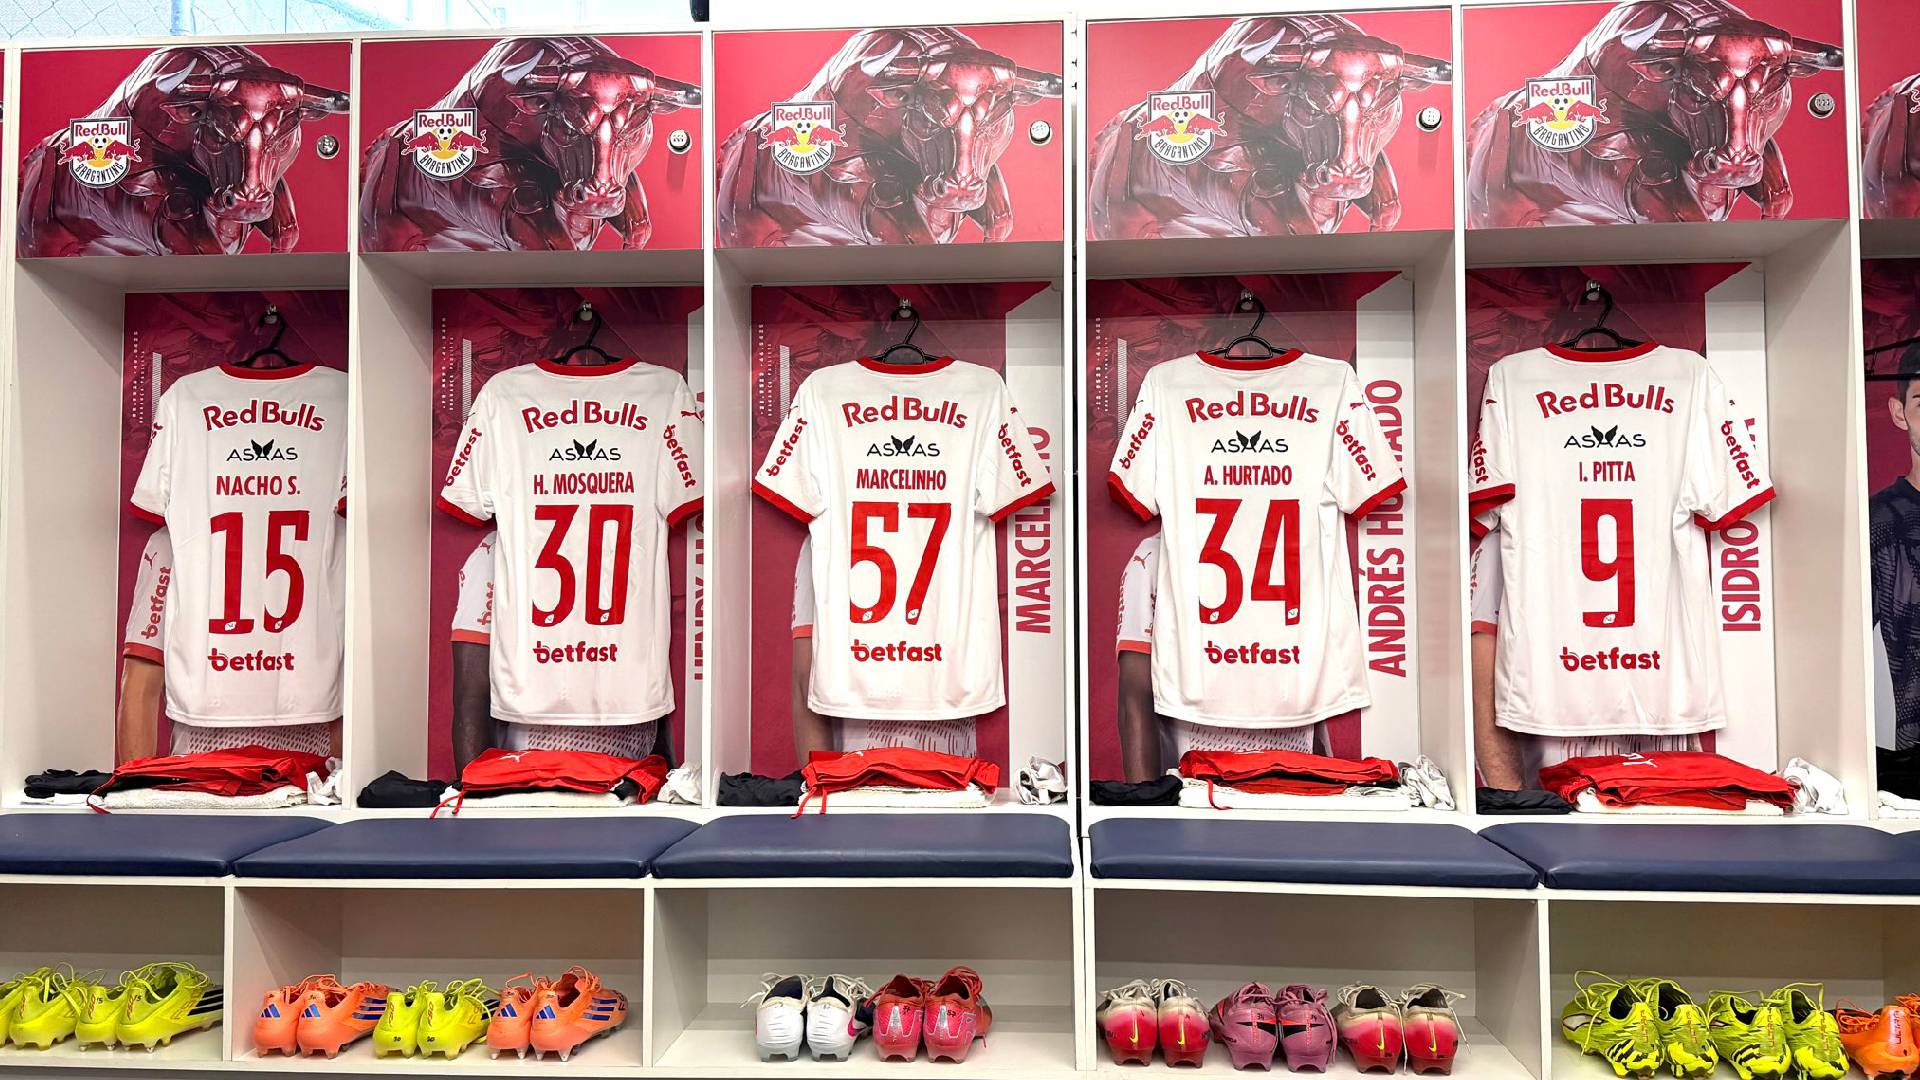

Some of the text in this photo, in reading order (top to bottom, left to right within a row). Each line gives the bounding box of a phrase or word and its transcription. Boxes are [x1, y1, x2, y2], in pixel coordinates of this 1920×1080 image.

[203, 400, 325, 433] Red Bulls
[522, 400, 649, 433] Red Bulls
[843, 395, 968, 430] Red Bulls
[1185, 391, 1319, 424] Red Bulls
[1536, 383, 1675, 418] Red Bulls
[446, 427, 482, 488] betfast
[663, 424, 696, 488] betfast
[766, 416, 808, 478] betfast
[998, 423, 1031, 487] betfast
[1119, 413, 1155, 470] betfast
[1335, 419, 1377, 482] betfast
[1720, 419, 1761, 490] betfast
[216, 475, 301, 496] NACHO S.
[533, 471, 635, 495] H. MOSQUERA
[856, 468, 947, 491] MARCELINHO
[1204, 464, 1293, 486] A. HURTADO
[1579, 461, 1636, 482] I. PITTA
[208, 509, 310, 636] 15
[531, 503, 634, 628] 30
[849, 500, 952, 625] 57
[1195, 497, 1301, 626] 34
[1580, 497, 1636, 629] 9
[1719, 519, 1761, 631] ISIDRO
[141, 566, 171, 639] betfast
[1359, 547, 1406, 677] ANDRÉS
[207, 647, 295, 672] betfast
[533, 641, 617, 665] betfast
[850, 639, 942, 663] betfast
[1204, 641, 1300, 665] betfast
[1560, 646, 1661, 673] betfast
